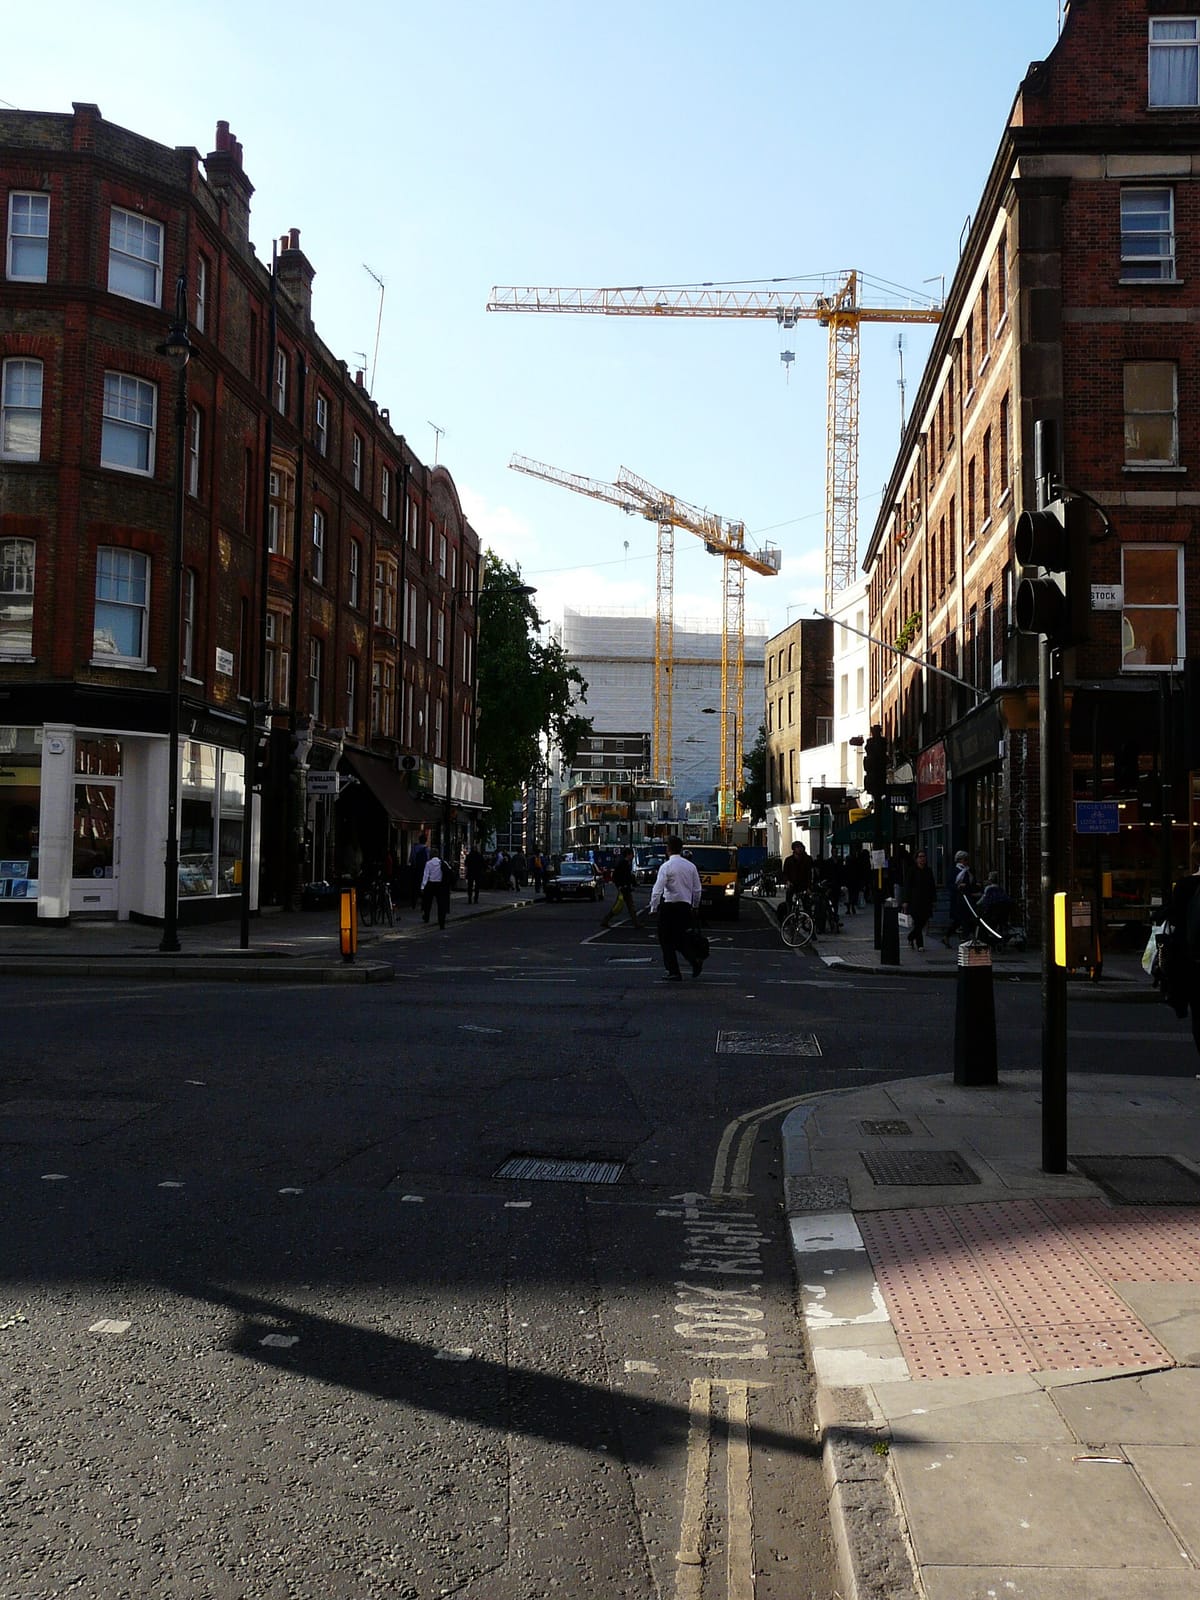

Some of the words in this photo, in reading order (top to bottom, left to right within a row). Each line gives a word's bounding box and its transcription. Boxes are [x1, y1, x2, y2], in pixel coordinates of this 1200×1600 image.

[890, 795, 908, 804] HILL
[680, 1208, 772, 1275] RIGHT
[673, 1281, 769, 1359] LOOK
